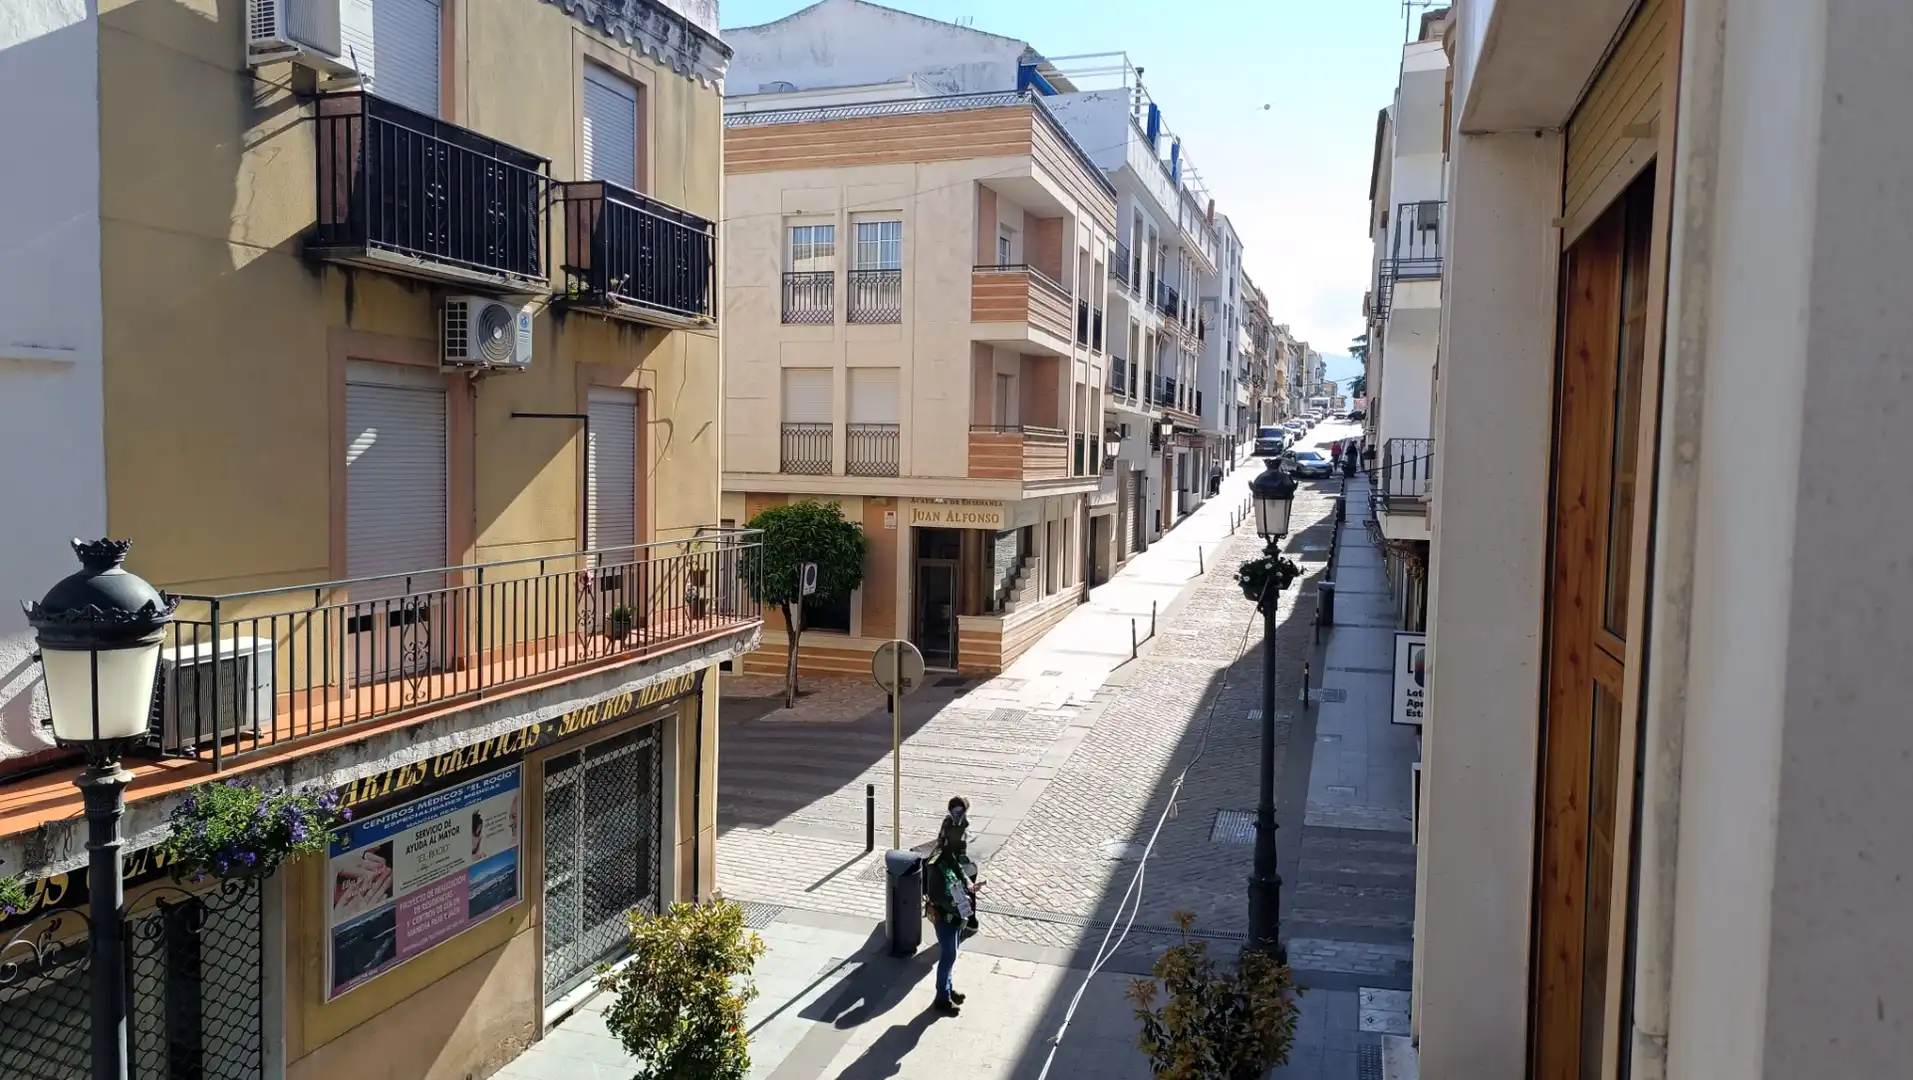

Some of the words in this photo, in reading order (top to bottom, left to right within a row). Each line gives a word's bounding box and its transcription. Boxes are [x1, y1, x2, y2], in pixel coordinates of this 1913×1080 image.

[912, 508, 941, 524] JUAN
[946, 509, 1000, 524] ALFONSO
[557, 691, 633, 737] SEGUROS
[362, 805, 415, 830] CENTROS
[417, 788, 464, 811] MÉDICOS
[383, 797, 462, 830] ESPECIALIDADES
[405, 839, 428, 856] AYUDA
[429, 835, 437, 846] AL
[437, 825, 460, 842] MAYOR
[415, 823, 443, 841] SERVICIO
[443, 819, 452, 830] DE
